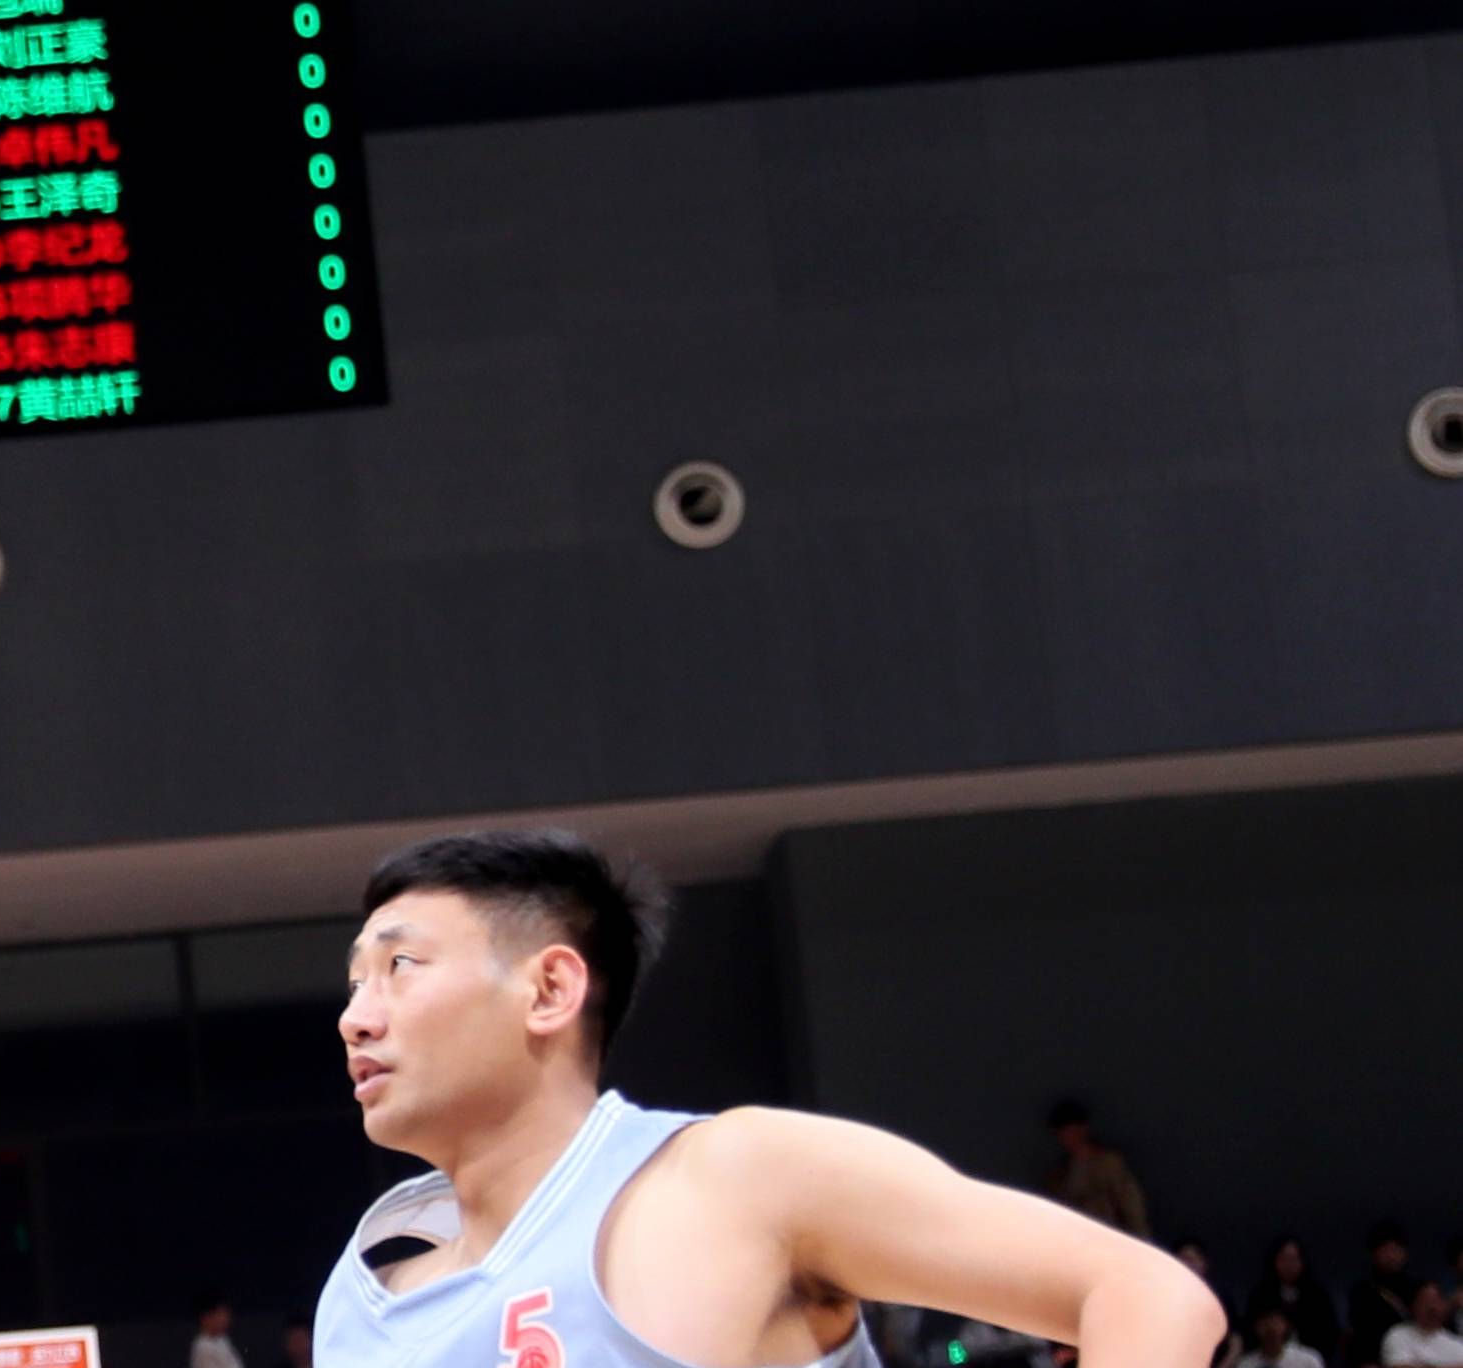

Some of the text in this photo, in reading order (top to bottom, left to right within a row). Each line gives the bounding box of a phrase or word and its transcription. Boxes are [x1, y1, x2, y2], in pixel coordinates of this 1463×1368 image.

[293, 2, 321, 38] 0
[298, 53, 326, 89] 0
[303, 103, 331, 139] 0
[308, 153, 336, 189] 0
[313, 204, 341, 240] 0
[318, 254, 346, 291] 0
[323, 304, 351, 341] 0
[328, 356, 357, 393] 0
